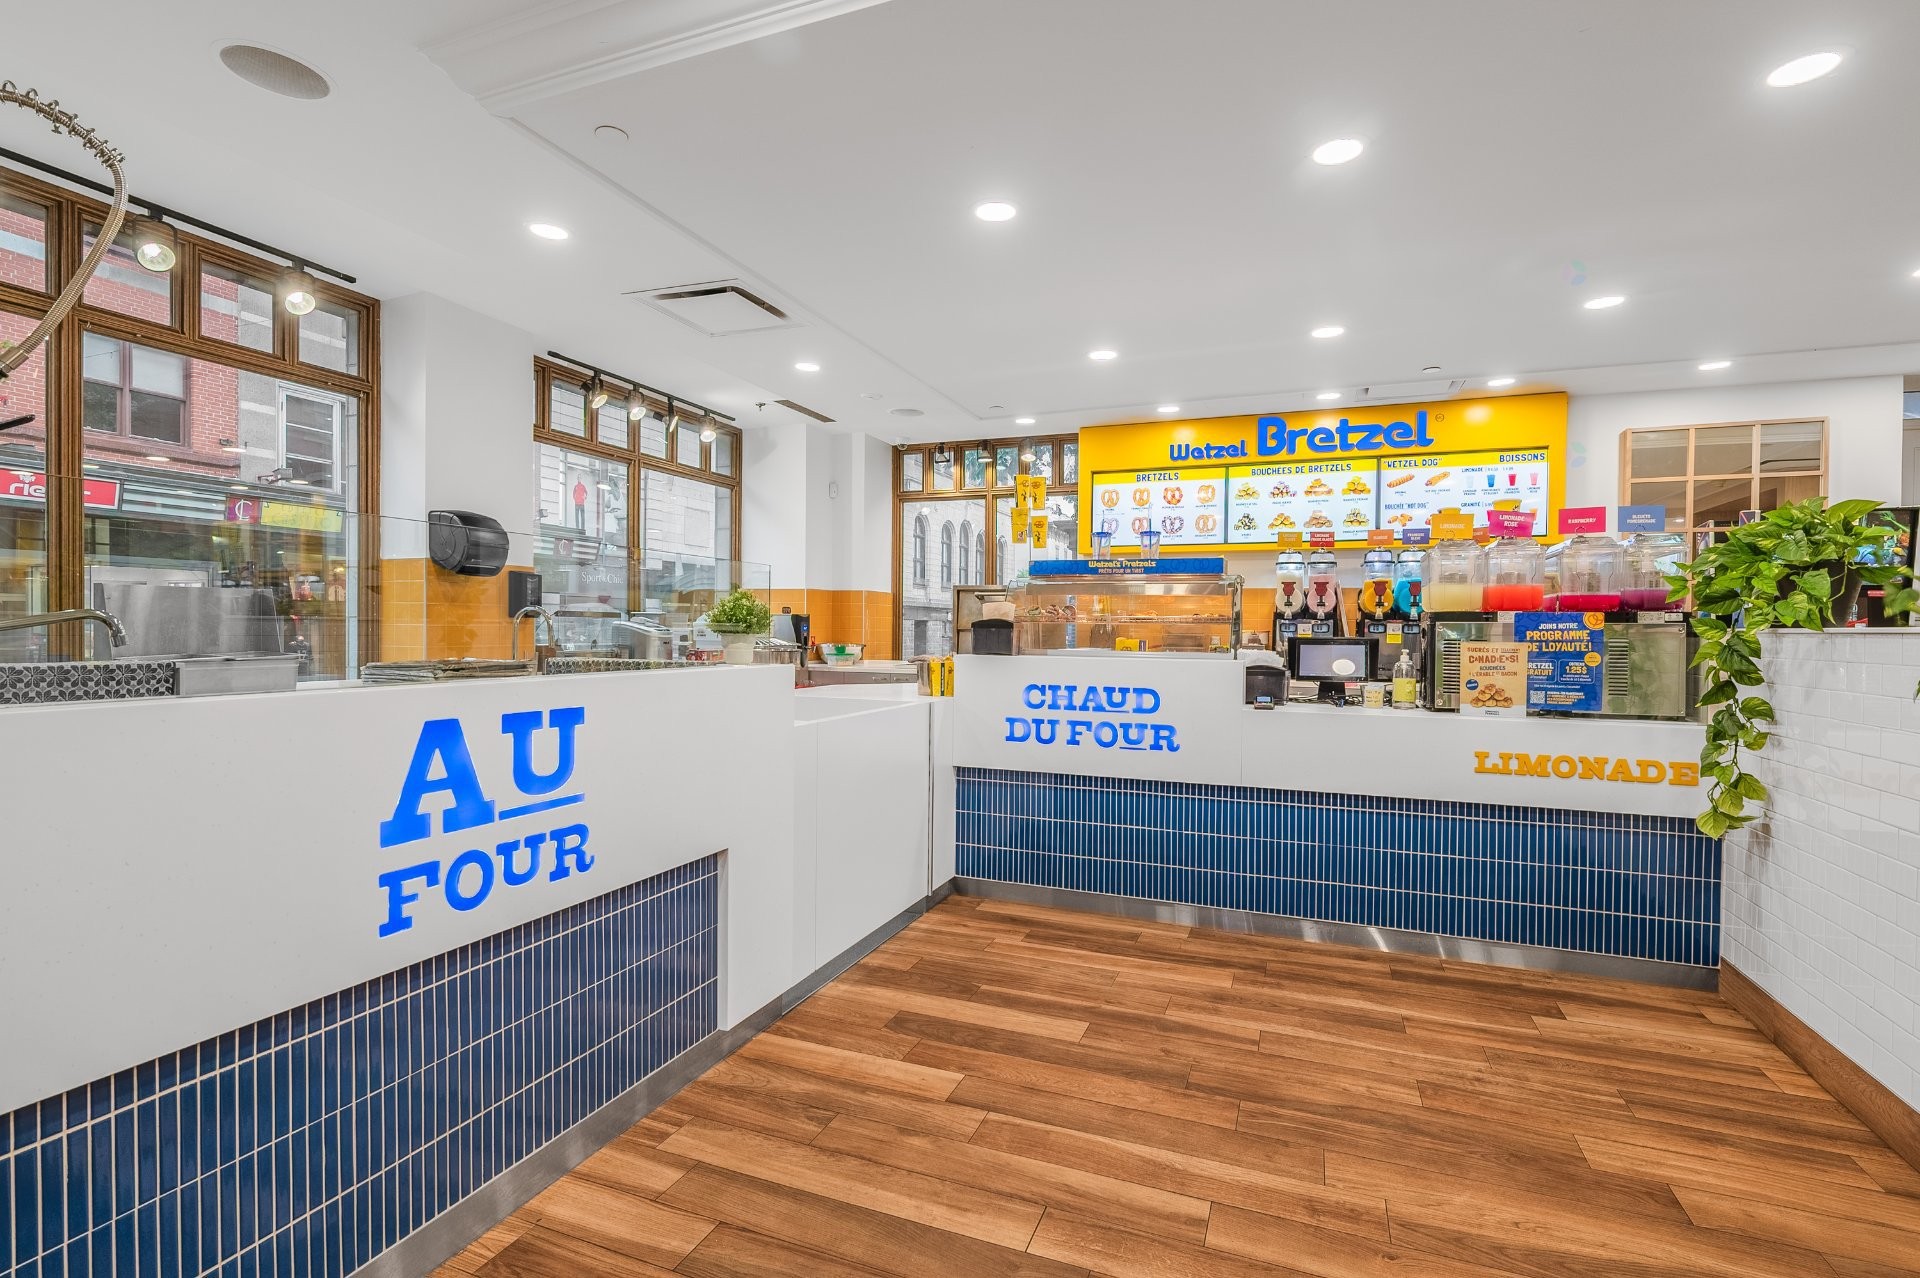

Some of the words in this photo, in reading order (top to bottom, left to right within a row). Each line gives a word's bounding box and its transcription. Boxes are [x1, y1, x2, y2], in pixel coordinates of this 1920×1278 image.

[1169, 440, 1247, 461] Wetzel
[1257, 411, 1433, 456] Bretzel
[1295, 465, 1305, 473] DE
[1308, 463, 1352, 473] BRETZELS
[1499, 453, 1545, 463] BOISSONS
[1136, 472, 1179, 482] BRETZELS
[1088, 560, 1121, 568] Wetzel's
[1122, 560, 1157, 568] Pretzels
[1526, 630, 1590, 641] PROGRAMME
[1542, 640, 1592, 652] LOYAUTÉ!
[1022, 683, 1161, 713] CHAUD
[1005, 717, 1060, 745] DU
[1066, 719, 1181, 753] FOUR
[380, 707, 585, 848] AU
[1474, 751, 1699, 786] LIMONADE
[379, 823, 595, 938] FOUR
